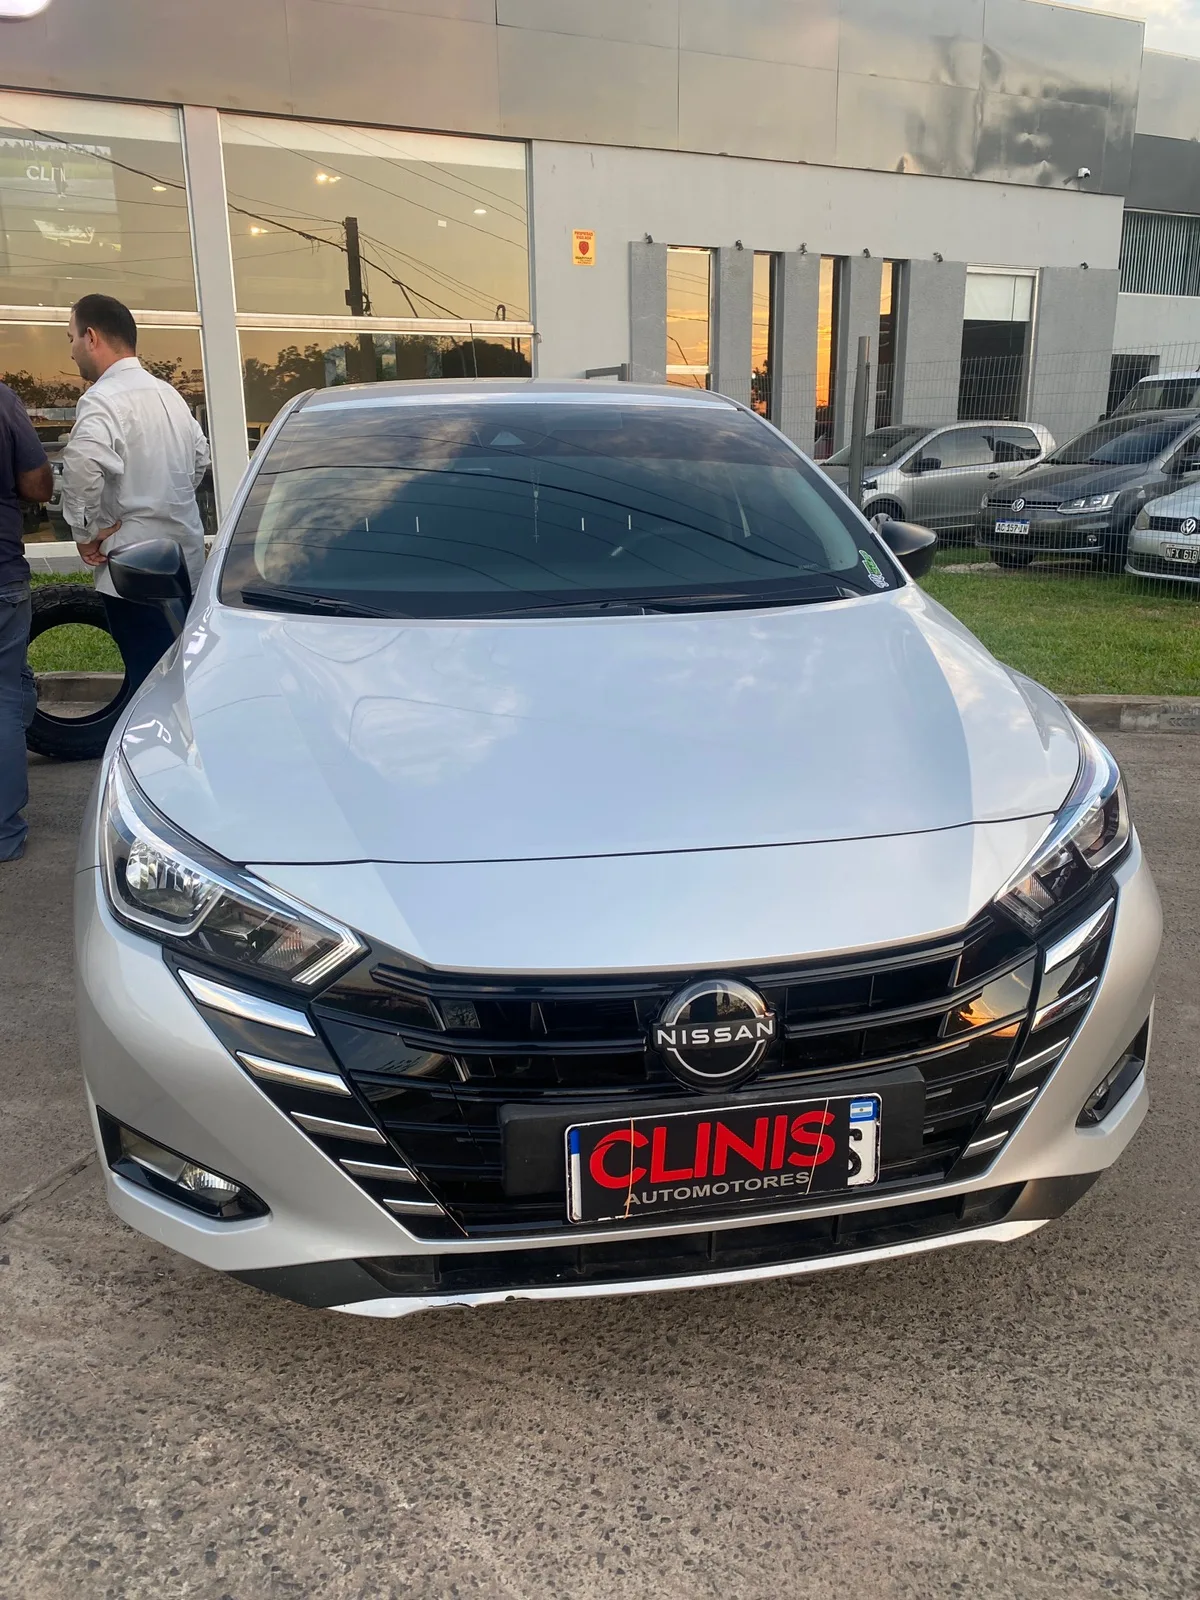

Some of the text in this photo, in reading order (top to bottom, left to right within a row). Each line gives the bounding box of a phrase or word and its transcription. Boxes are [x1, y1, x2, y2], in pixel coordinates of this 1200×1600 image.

[657, 1020, 773, 1045] NISSAN
[589, 1110, 836, 1189] CLINIS
[624, 1171, 810, 1207] AUTOMOTORES
